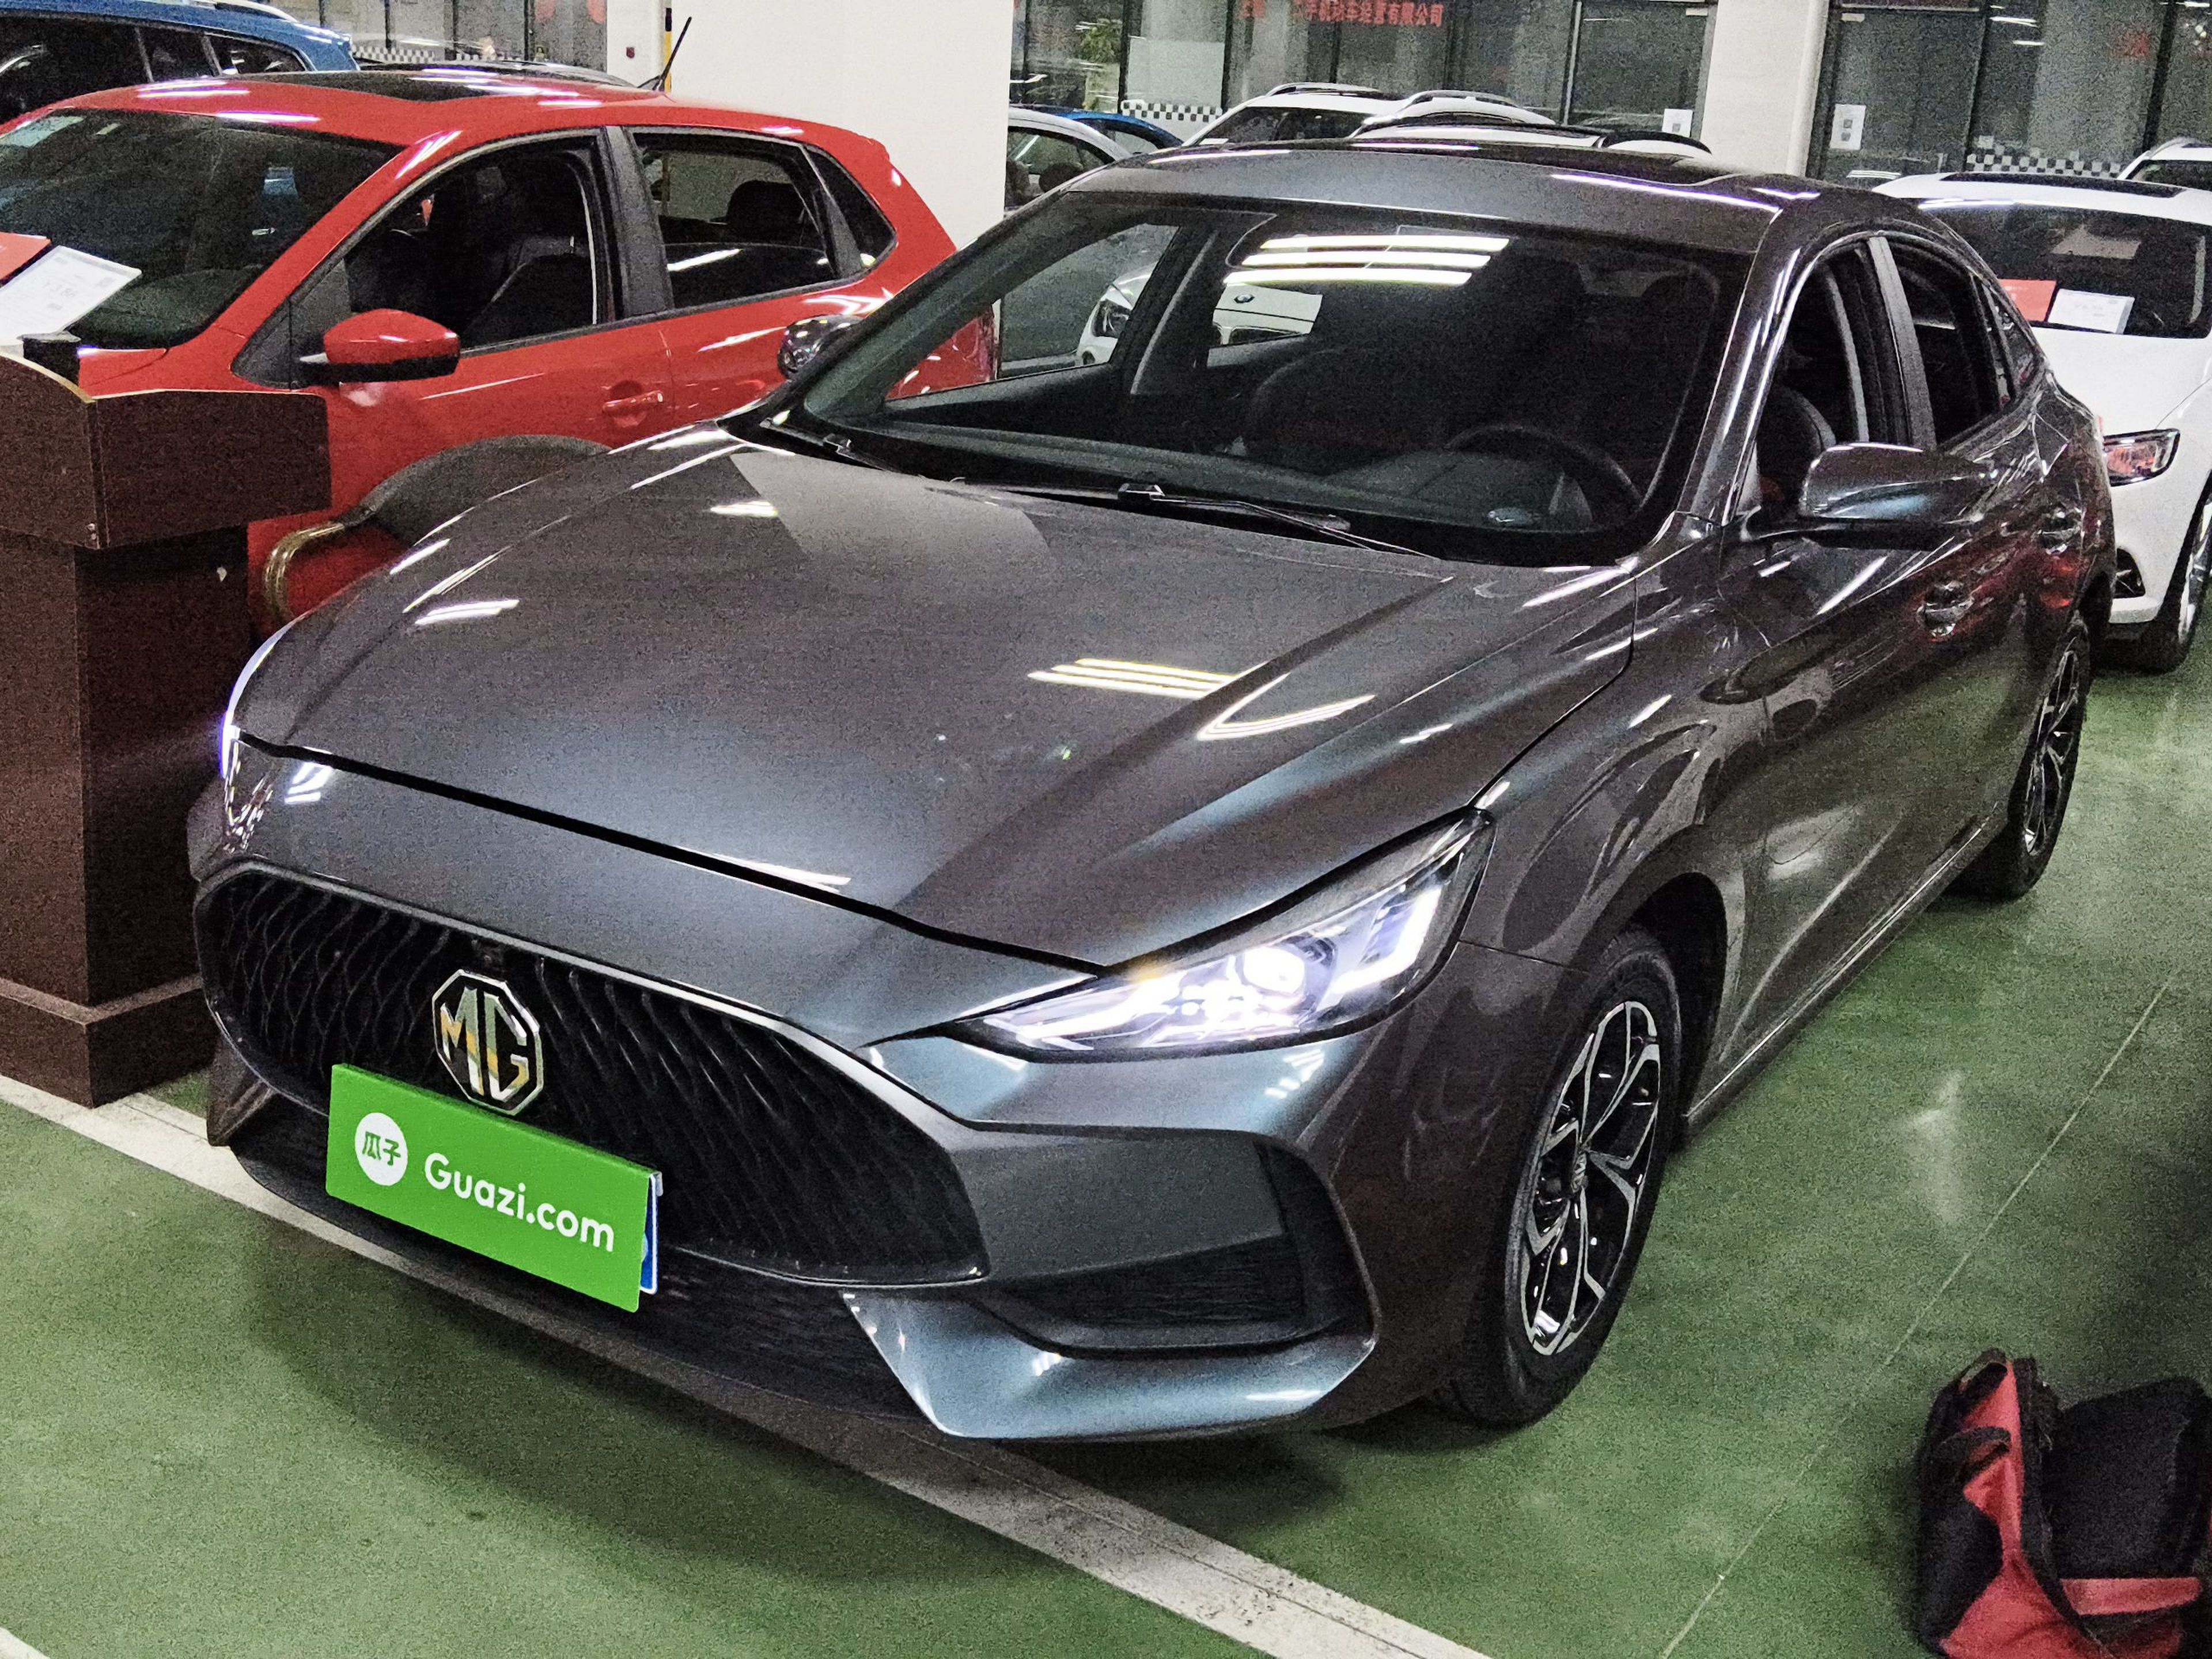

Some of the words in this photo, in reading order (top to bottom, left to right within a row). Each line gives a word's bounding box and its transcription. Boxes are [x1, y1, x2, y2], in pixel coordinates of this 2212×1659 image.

[440, 986, 530, 1102] MG
[361, 1130, 402, 1167] 瓜子
[425, 1152, 615, 1252] Guazi.com
